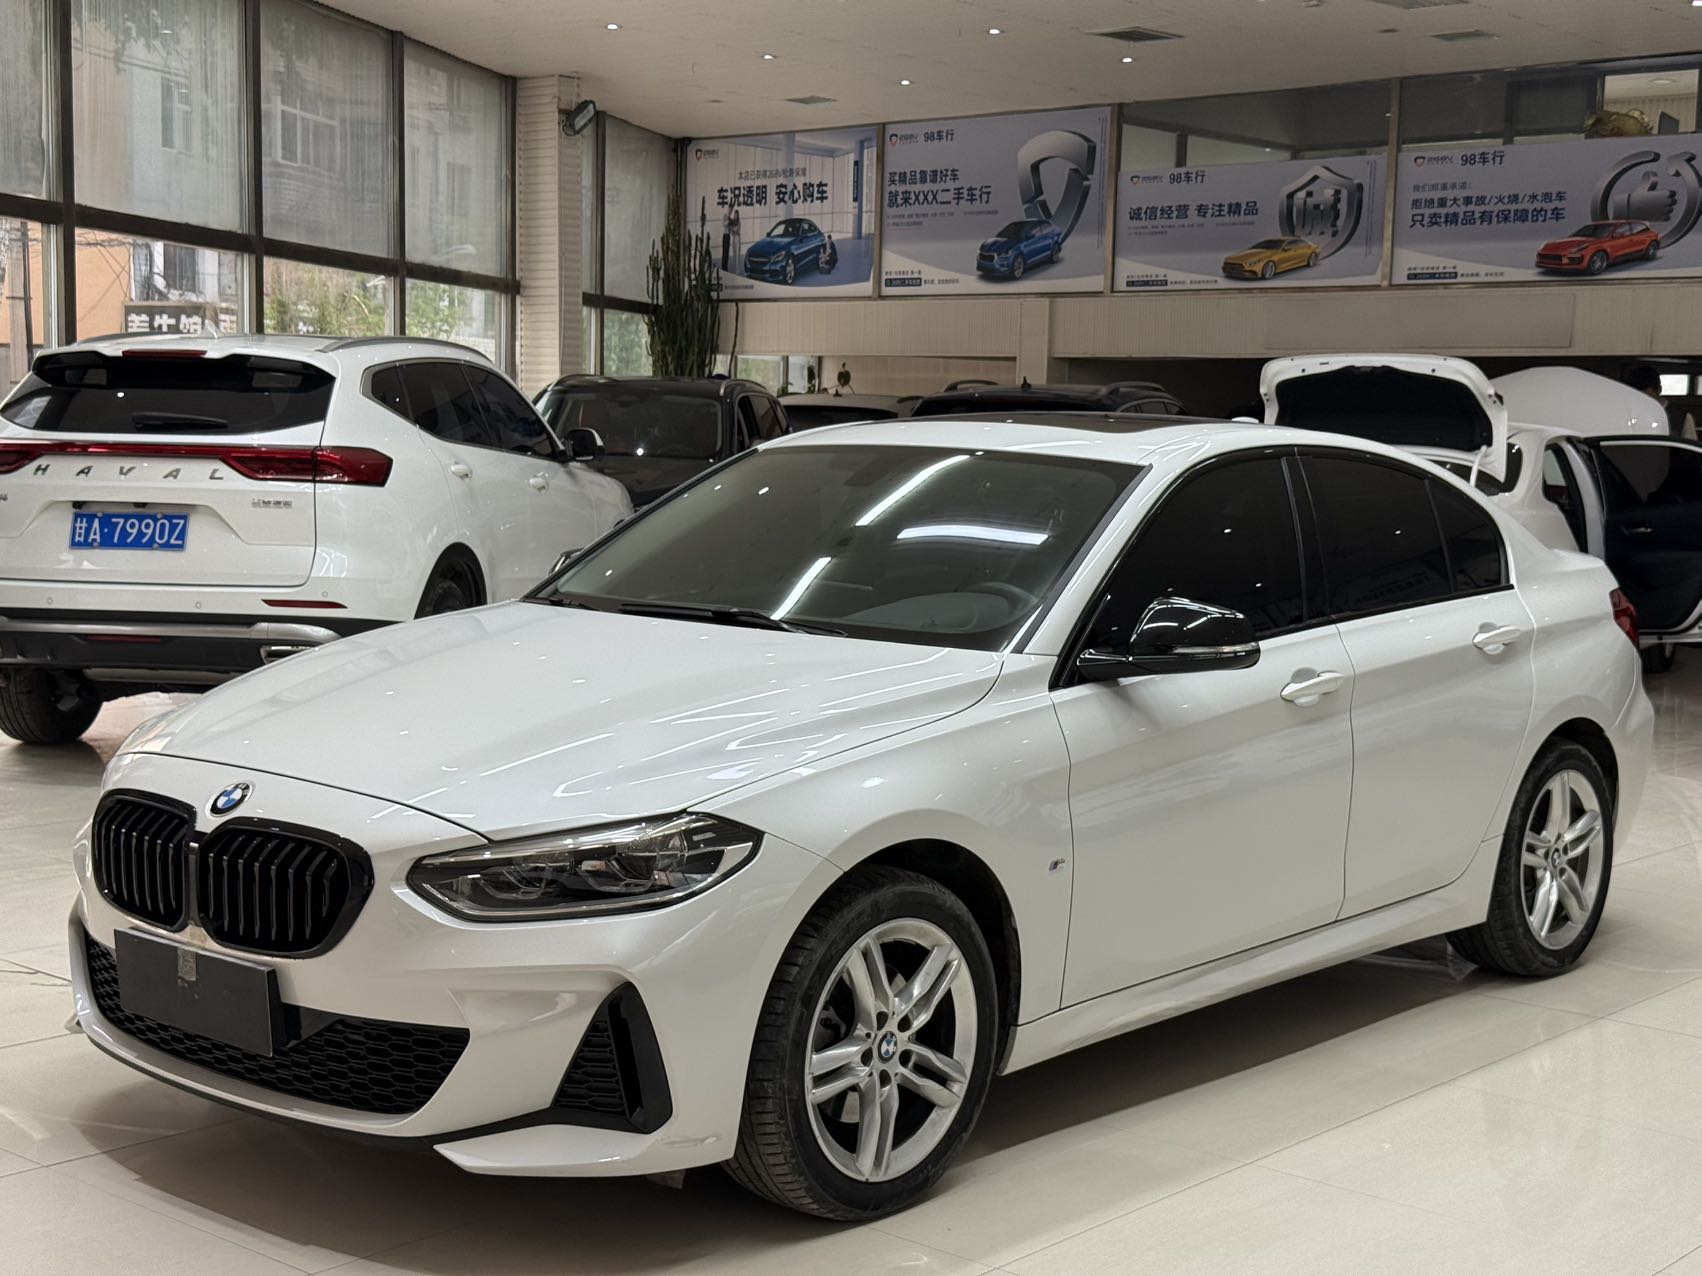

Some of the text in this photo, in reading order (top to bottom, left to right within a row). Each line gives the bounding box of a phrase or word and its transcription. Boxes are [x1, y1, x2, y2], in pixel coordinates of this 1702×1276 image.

[923, 129, 955, 144] 98车行
[1460, 151, 1505, 167] 98车行
[887, 168, 960, 187] 买精品靠谱好车
[1169, 170, 1206, 185] 98车行
[716, 184, 768, 208] 车况透明
[774, 180, 829, 206] 安心购车
[887, 185, 992, 209] 就来XXX二手车行
[1128, 200, 1259, 222] 诚信经营 专注精品
[1409, 206, 1566, 229] 只卖精品有保障的车
[33, 464, 225, 481] HAVAL
